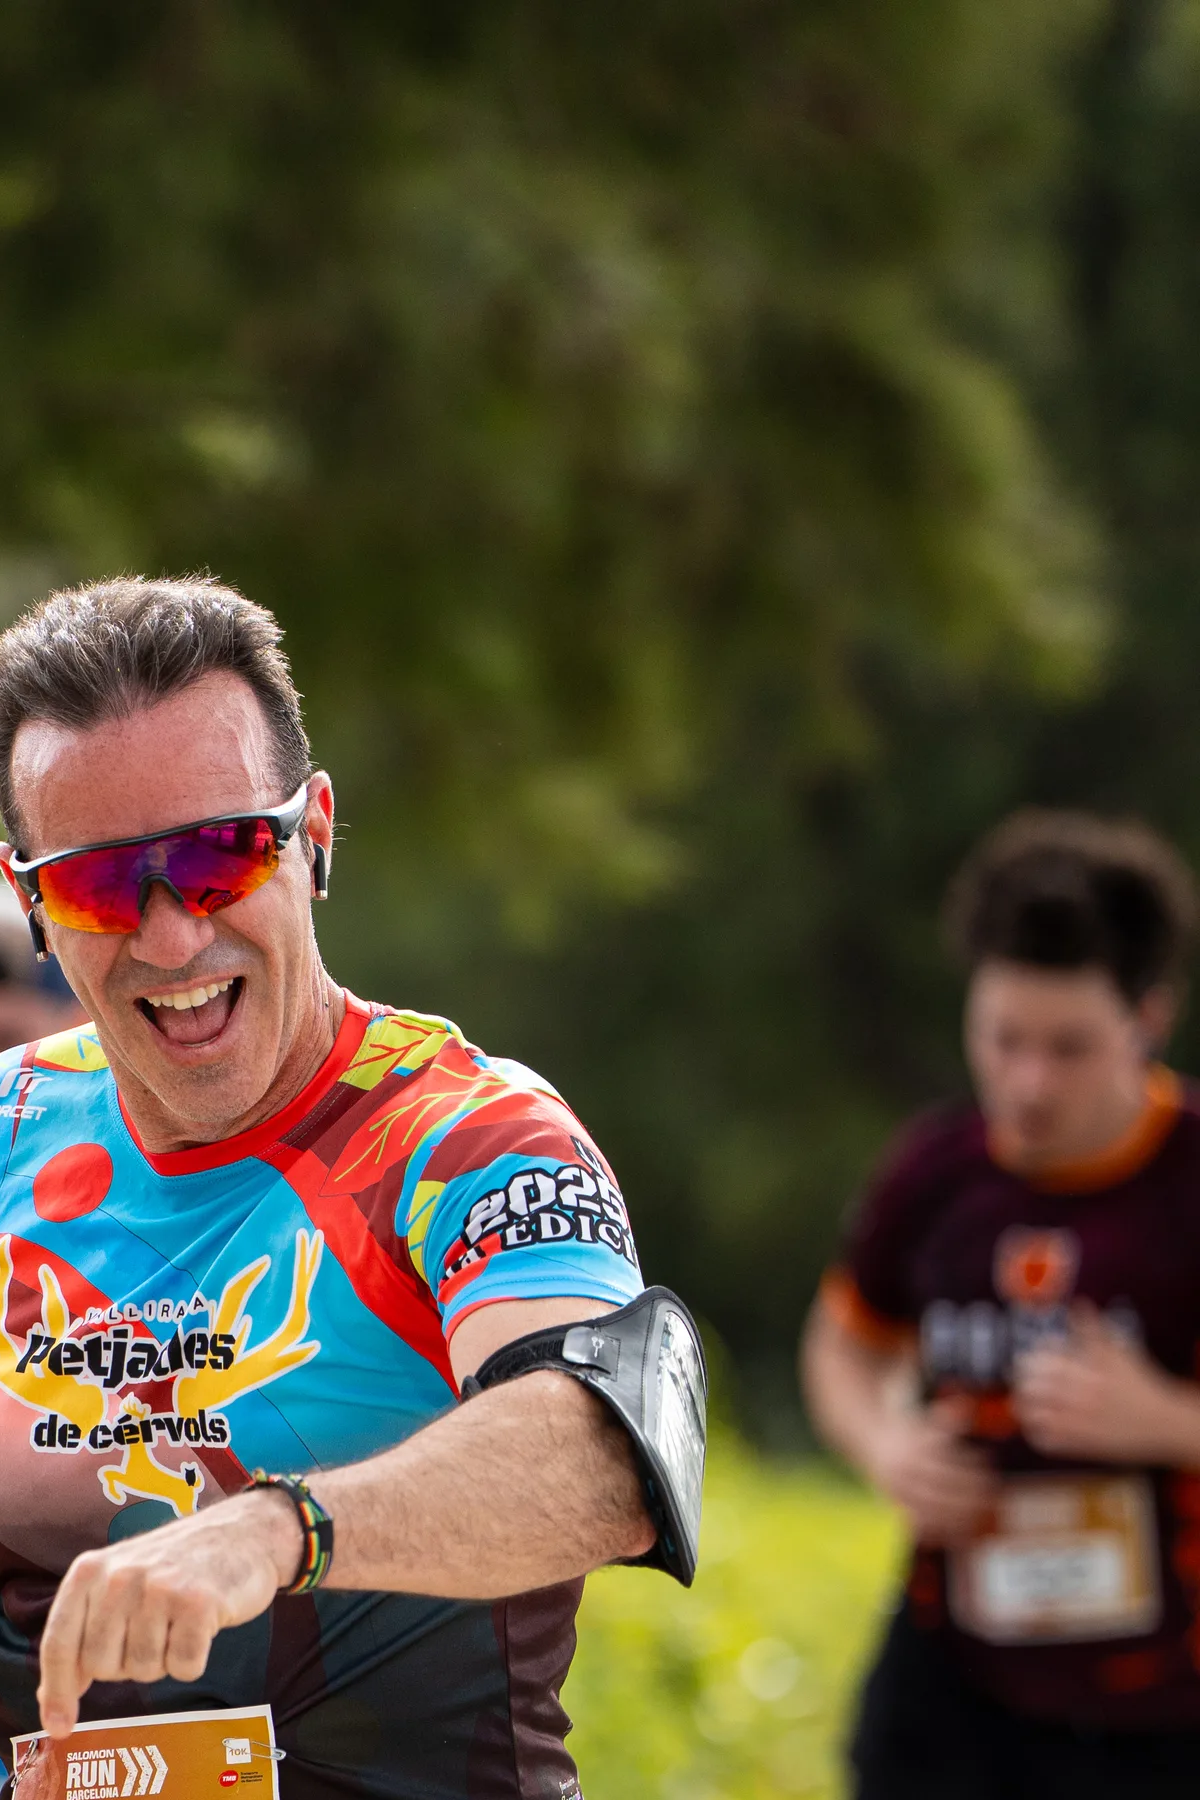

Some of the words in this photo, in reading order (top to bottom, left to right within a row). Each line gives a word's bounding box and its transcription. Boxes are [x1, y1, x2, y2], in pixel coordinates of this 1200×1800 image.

[464, 1166, 630, 1244] 2025
[15, 1328, 236, 1389] Petjades
[33, 1414, 82, 1448] de
[88, 1408, 228, 1450] cérvols
[66, 1749, 115, 1762] SALOMON
[229, 1748, 248, 1756] 10K
[66, 1759, 116, 1789] RUN
